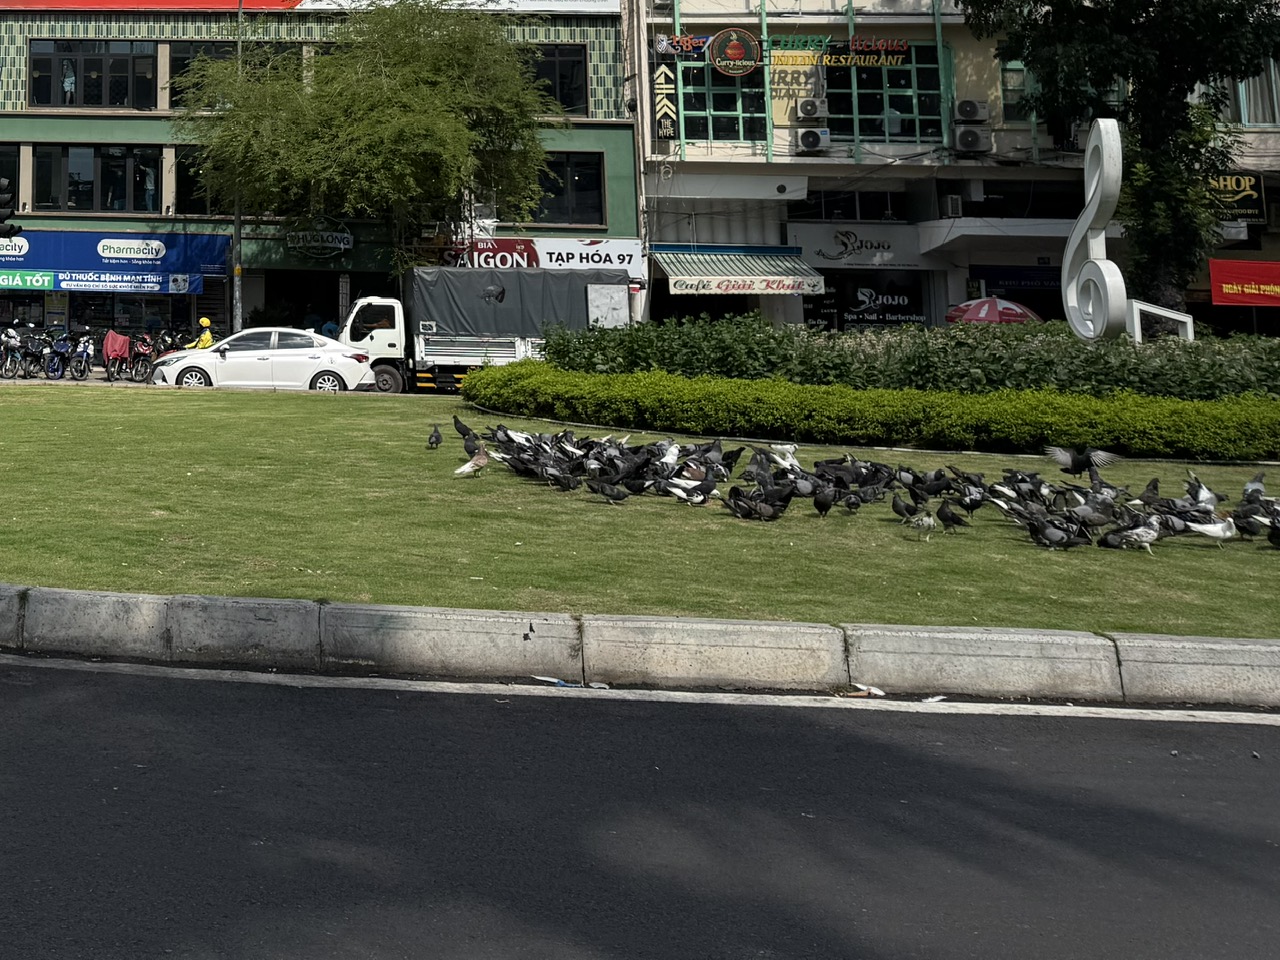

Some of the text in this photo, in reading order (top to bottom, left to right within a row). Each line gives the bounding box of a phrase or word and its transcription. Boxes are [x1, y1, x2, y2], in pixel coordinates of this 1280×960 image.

[672, 34, 707, 51] Tiger
[768, 35, 831, 51] CURRY
[849, 34, 909, 51] licious
[716, 57, 755, 67] Curry-licious
[773, 54, 906, 66] INDIAN RESTAURANT
[661, 119, 672, 129] THE
[658, 128, 675, 137] HYPE
[1210, 175, 1256, 190] SHOP
[102, 243, 160, 257] Pharmacity
[856, 241, 891, 250] JOJO
[443, 251, 529, 268] SAIGON
[546, 250, 634, 267] TẠP HÓA 97
[0, 272, 51, 287] GIÁ TỐT
[58, 272, 69, 280] ĐỦ
[71, 271, 100, 281] THUỐC
[100, 273, 122, 283] BỆNH
[143, 274, 162, 282] TÍNH
[673, 279, 713, 292] Café
[876, 294, 909, 305] JOJO
[844, 312, 926, 322] Spa Nail Barbershop
